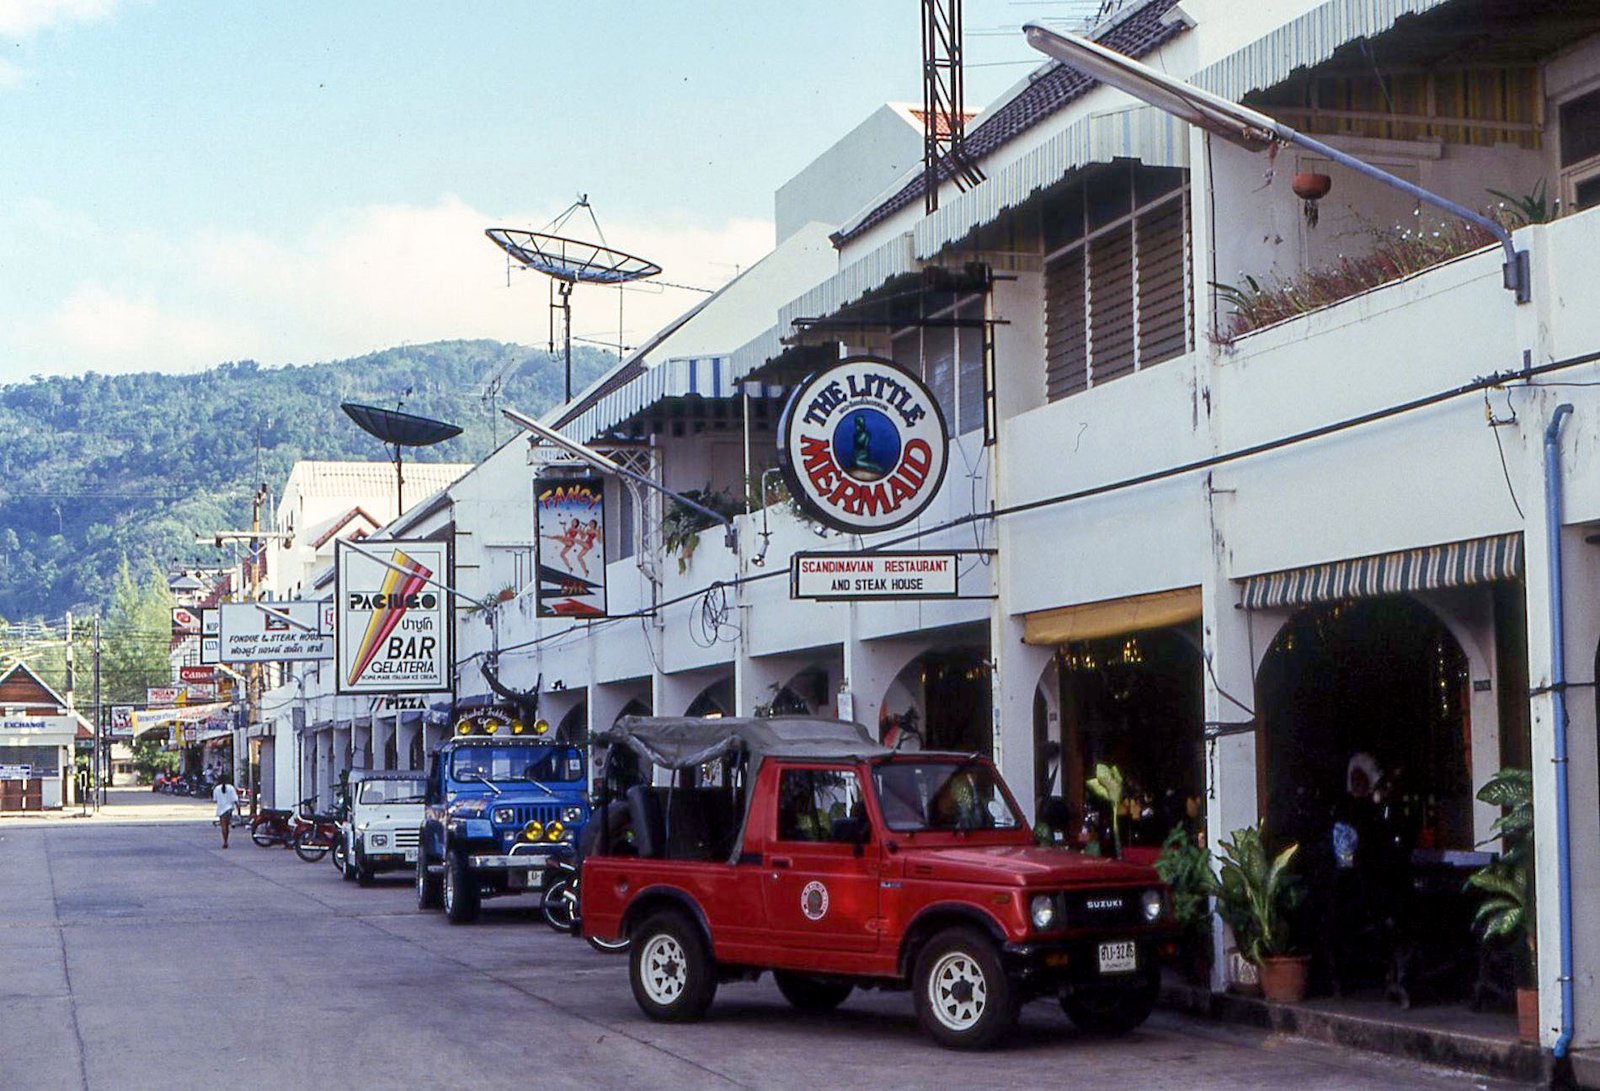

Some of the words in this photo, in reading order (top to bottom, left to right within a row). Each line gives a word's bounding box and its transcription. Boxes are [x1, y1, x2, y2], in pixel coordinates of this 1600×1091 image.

[802, 380, 847, 427] THE
[846, 373, 926, 427] LITTLE
[800, 434, 932, 516] MERMAID
[538, 484, 602, 510] FANCY
[802, 561, 874, 573] SCANDINAVIAN
[884, 560, 948, 572] RESTAURANT
[831, 579, 850, 591] AND
[855, 579, 887, 590] STEAK
[891, 578, 923, 590] HOUSE
[350, 593, 436, 609] PACIUGO
[229, 634, 259, 643] FONDUE
[270, 633, 297, 642] STEAK
[387, 636, 436, 659] BAR
[371, 661, 434, 673] GELATERIA
[385, 697, 427, 709] PIZZA
[4, 721, 46, 729] EXCHANGE
[1087, 900, 1122, 908] SUZUKI
